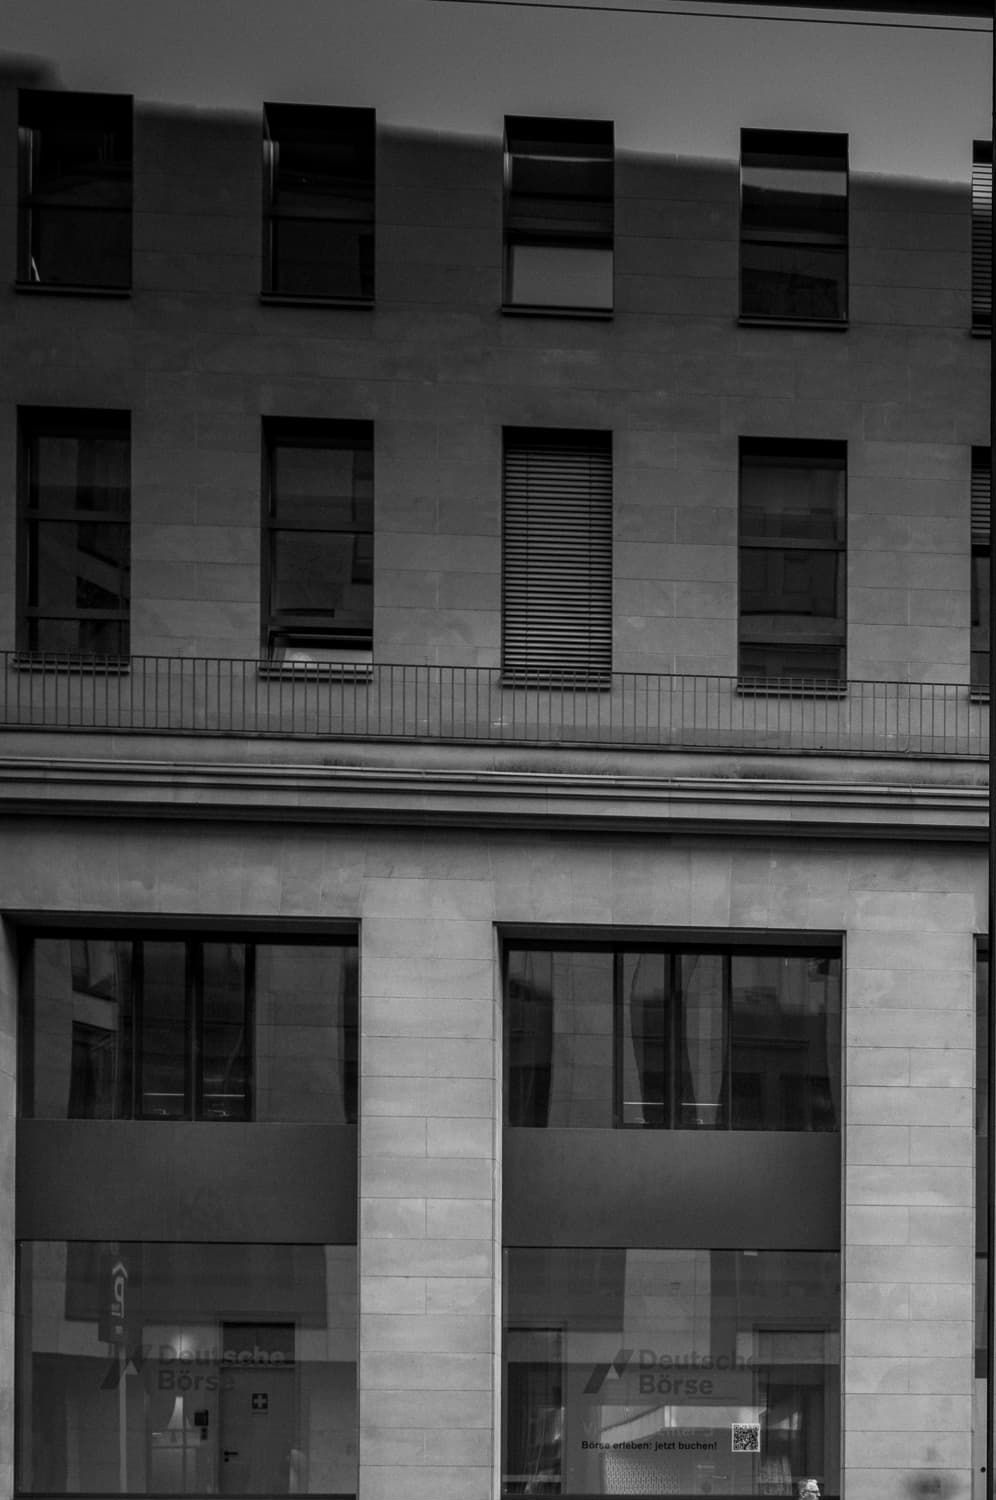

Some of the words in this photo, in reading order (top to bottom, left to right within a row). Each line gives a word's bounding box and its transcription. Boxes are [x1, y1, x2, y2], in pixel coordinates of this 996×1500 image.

[159, 1345, 286, 1365] Deutsche
[158, 1370, 236, 1391] Börse
[639, 1374, 713, 1395] Börse
[612, 1440, 652, 1450] erleben:
[654, 1440, 676, 1452] jetzt
[678, 1440, 717, 1450] buchen!
